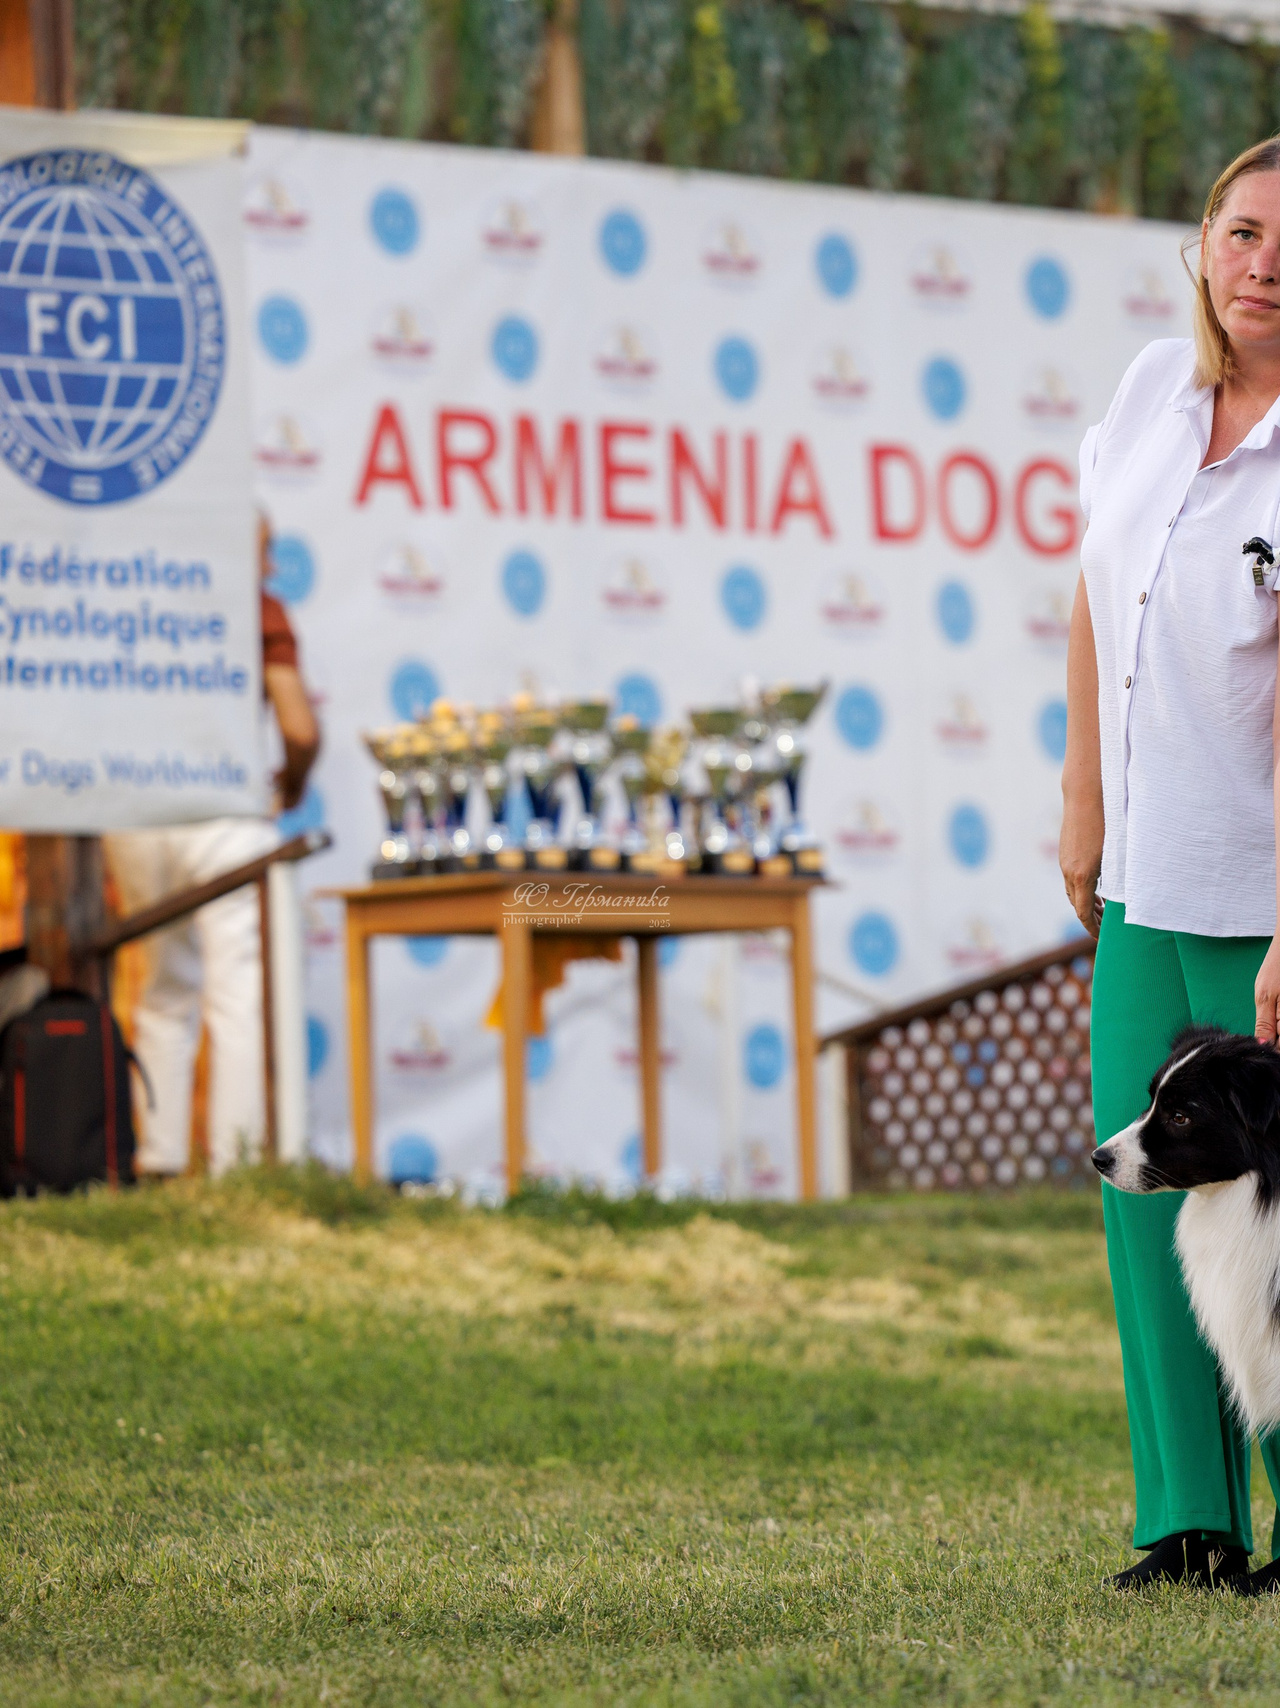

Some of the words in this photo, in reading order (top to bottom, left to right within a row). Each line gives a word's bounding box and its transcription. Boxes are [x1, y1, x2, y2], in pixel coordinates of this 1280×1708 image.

[25, 292, 138, 361] FCI
[354, 402, 837, 542] ARMENIA
[865, 441, 1079, 561] DOG
[0, 596, 227, 650] ynologique
[0, 652, 249, 694] ternationale
[21, 748, 97, 796] Dogs
